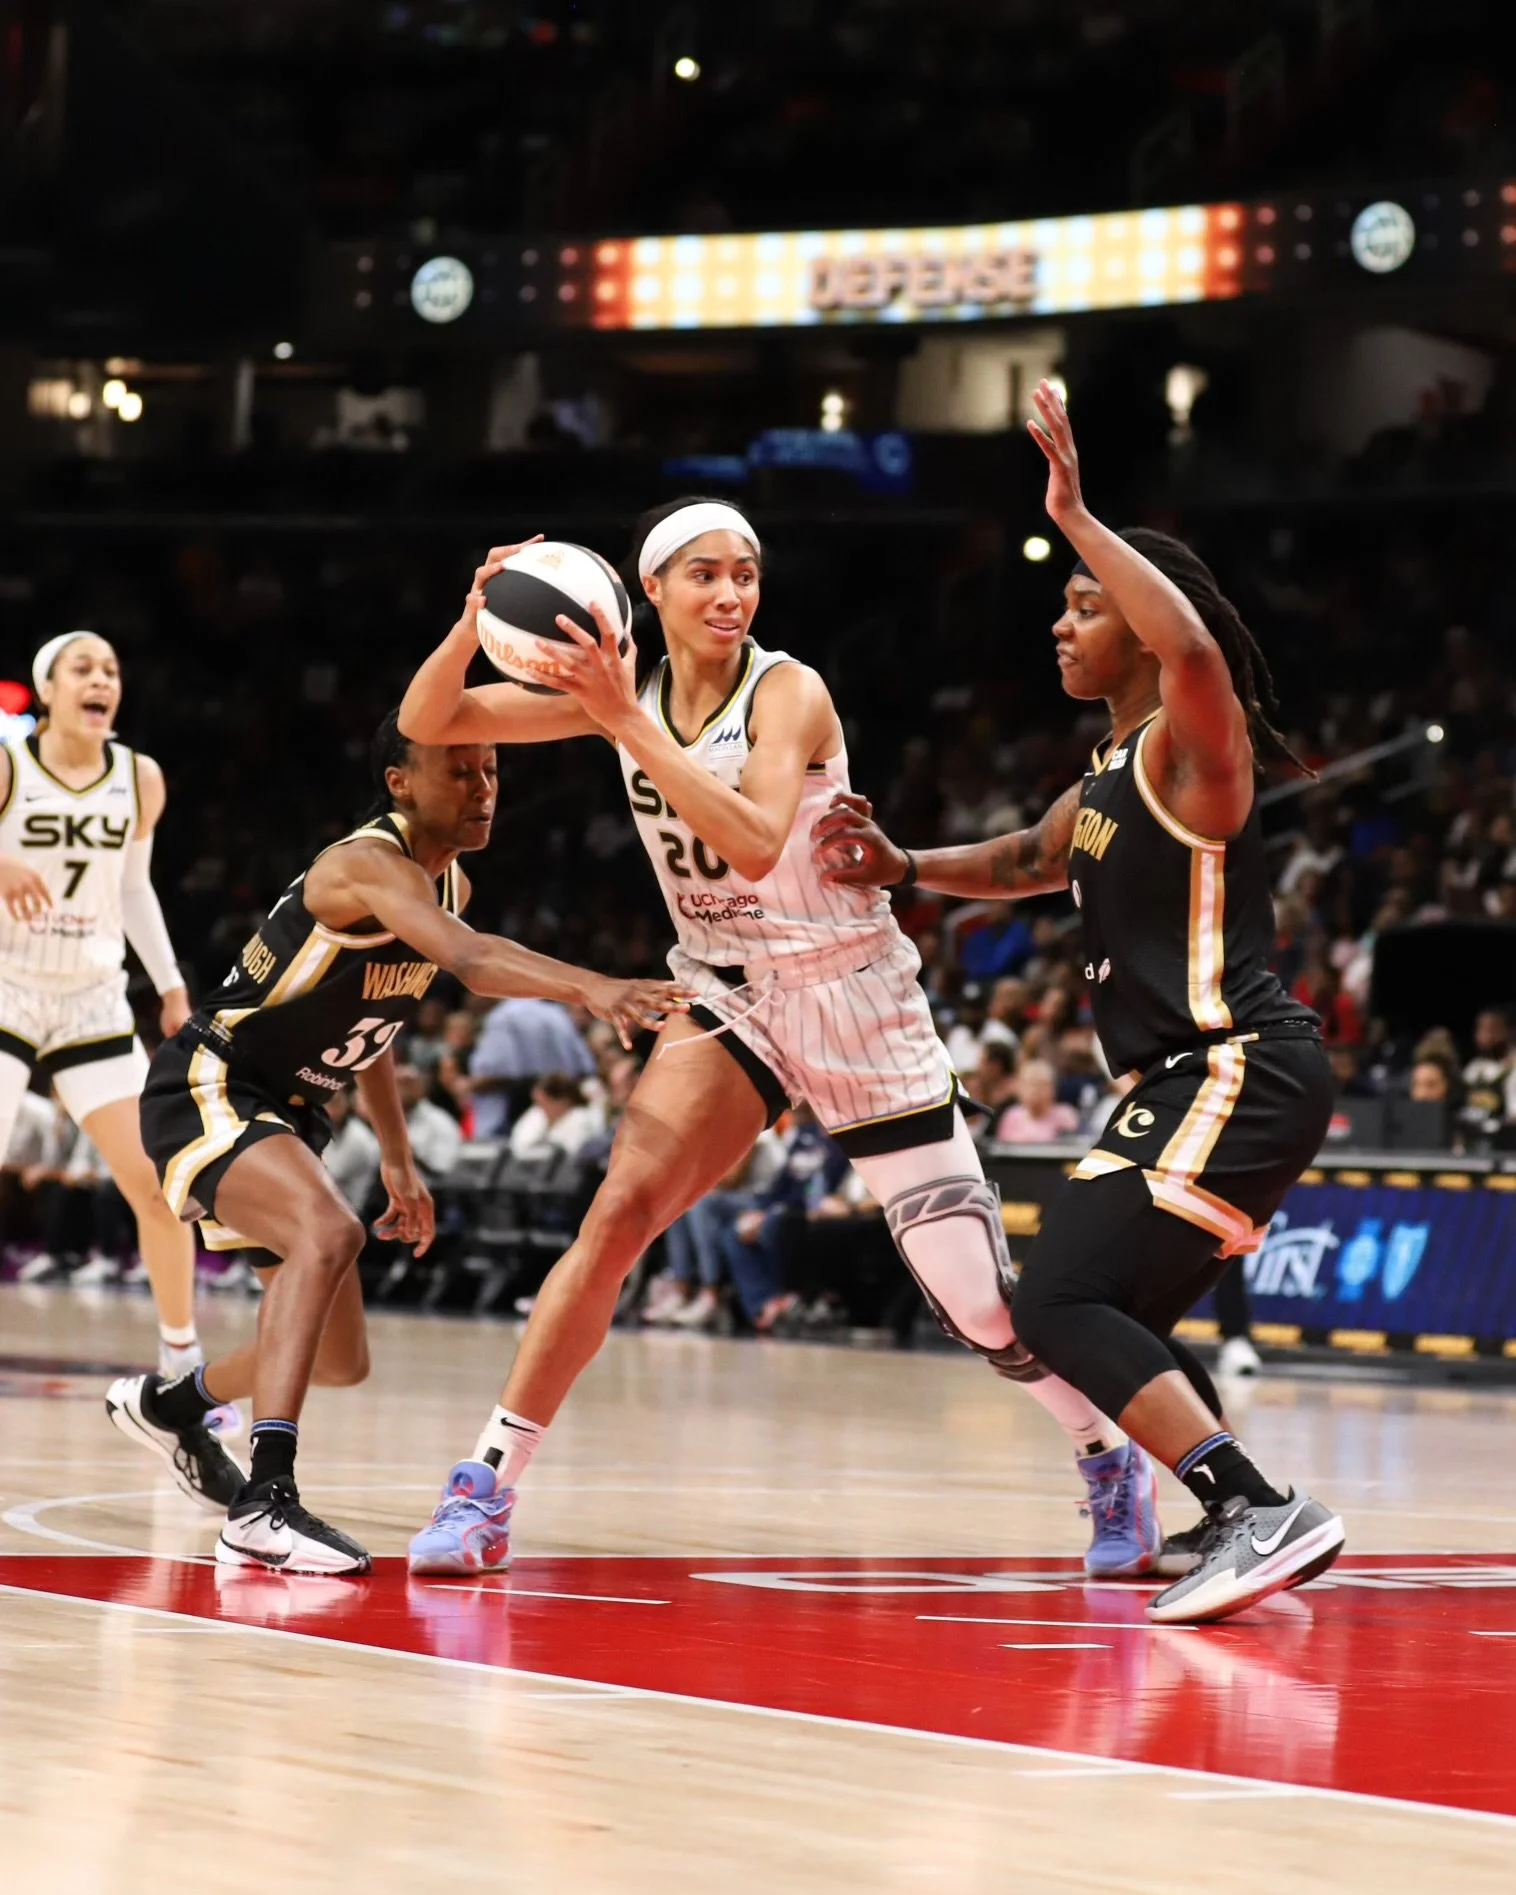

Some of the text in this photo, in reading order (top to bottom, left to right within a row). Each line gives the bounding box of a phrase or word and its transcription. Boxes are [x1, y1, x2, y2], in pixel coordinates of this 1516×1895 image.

[809, 247, 1040, 309] DEFENSE
[20, 814, 130, 850] SKY
[658, 831, 730, 880] 20
[62, 860, 90, 899] 7
